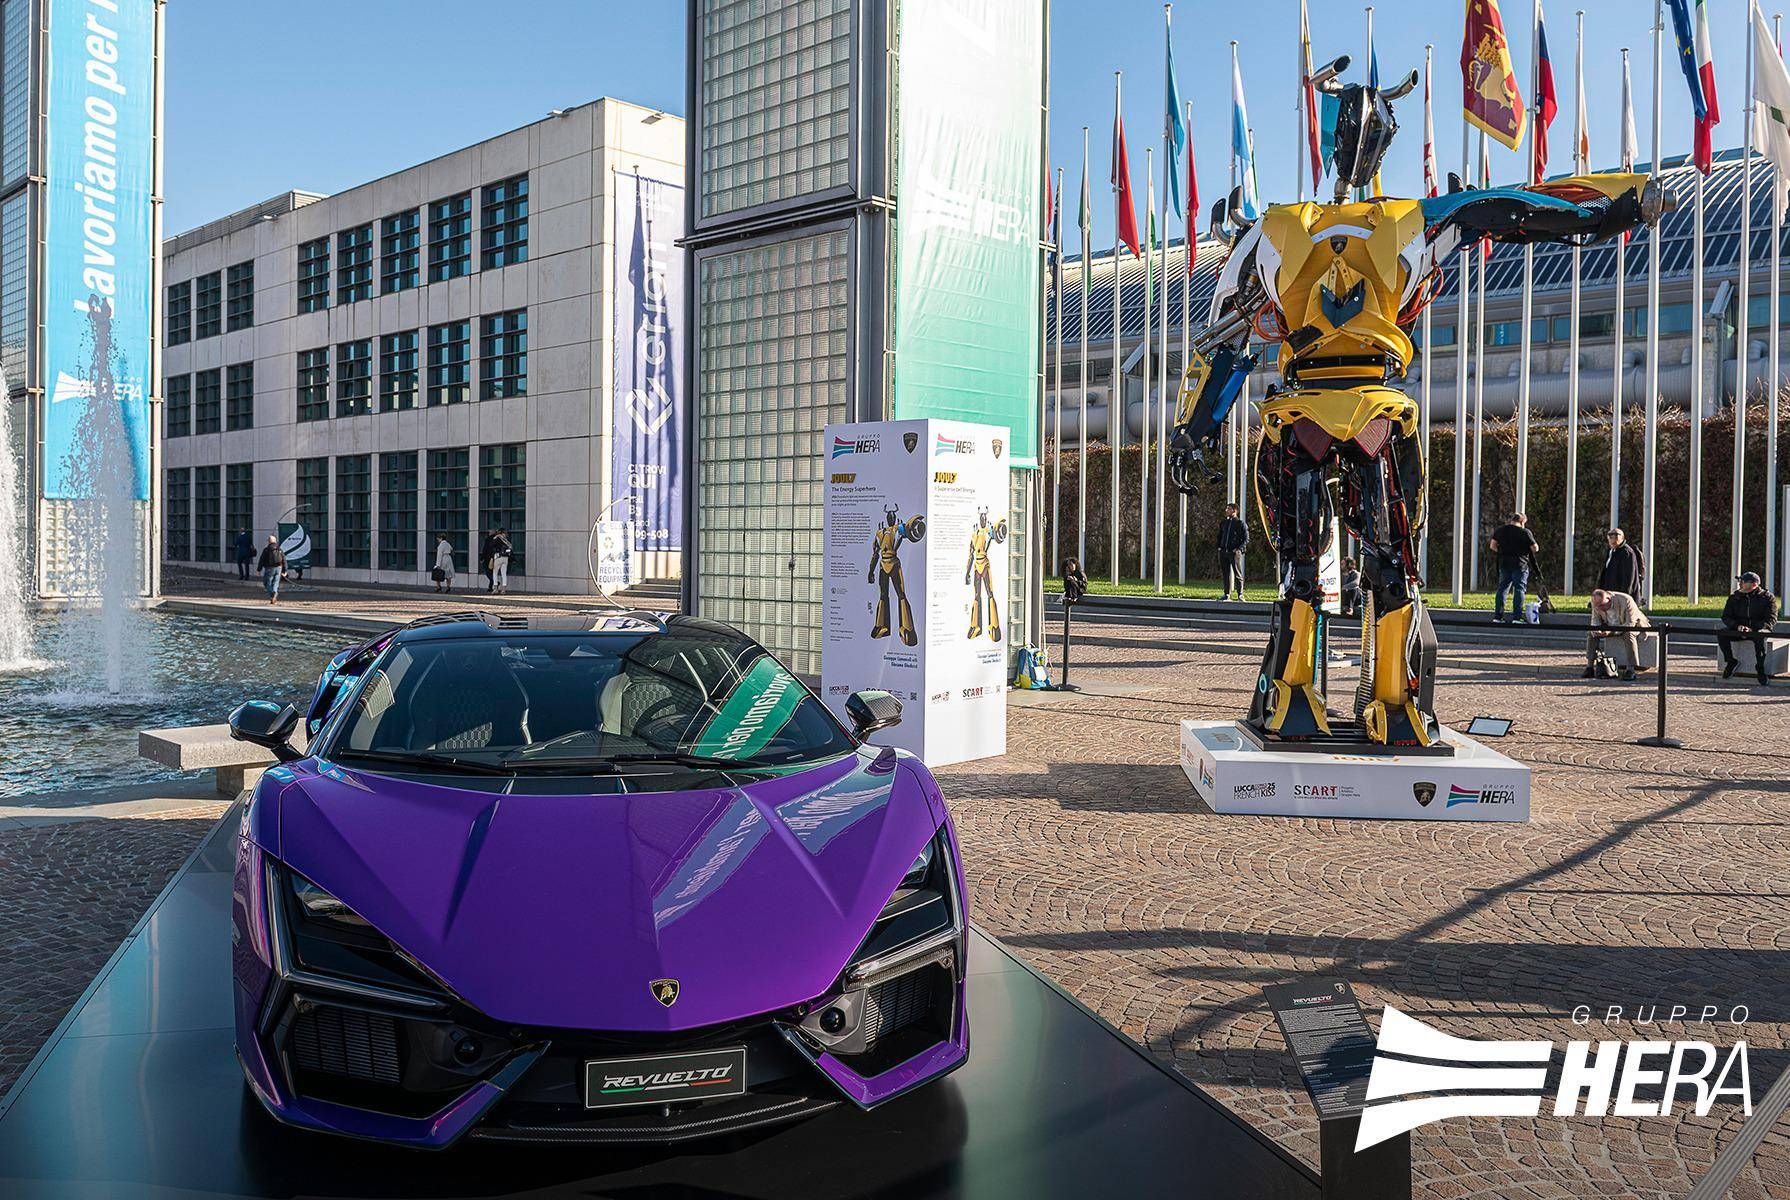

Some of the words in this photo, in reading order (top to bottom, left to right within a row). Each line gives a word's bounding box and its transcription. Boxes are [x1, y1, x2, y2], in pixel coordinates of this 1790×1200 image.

[86, 12, 126, 96] per
[74, 95, 117, 319] Lavoriamo
[976, 197, 1031, 247] HERA
[643, 241, 667, 367] erion
[855, 440, 881, 454] HERA
[639, 464, 666, 475] TROVI
[628, 474, 657, 489] QUI
[962, 686, 984, 698] SCART
[1233, 784, 1256, 792] LUCCA
[1294, 784, 1338, 796] SCART
[1480, 790, 1515, 804] HERA
[1293, 994, 1332, 1004] REVUELTO
[602, 1063, 733, 1089] REVUELTO
